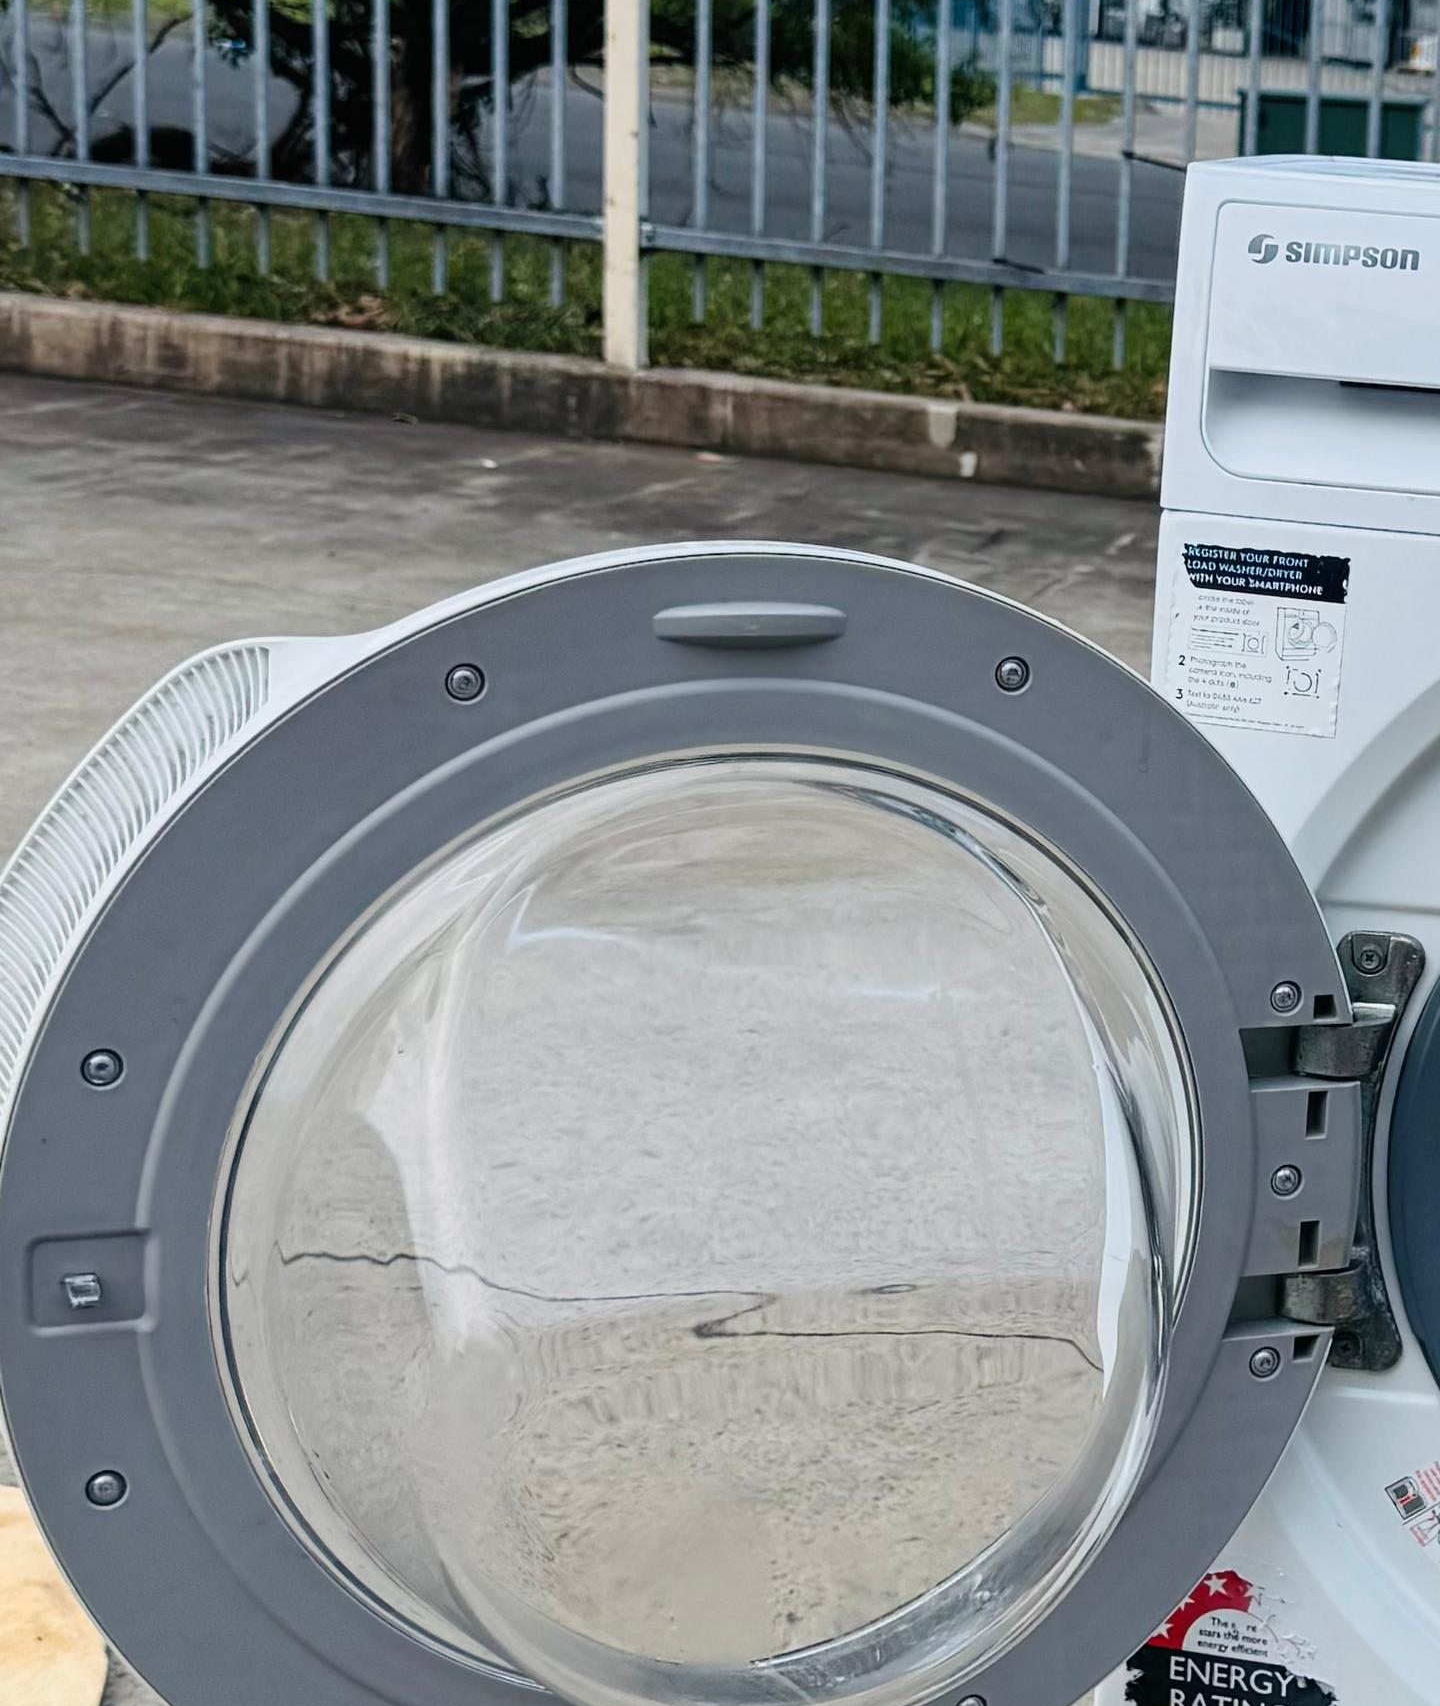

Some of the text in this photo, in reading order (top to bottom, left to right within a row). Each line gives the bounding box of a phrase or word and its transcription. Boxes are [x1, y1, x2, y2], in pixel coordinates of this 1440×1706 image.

[1285, 241, 1420, 271] SIMPSON
[1188, 546, 1309, 568] REGISTER YOUR FRONT
[1187, 559, 1303, 581] LOAD WASHER/DRYER
[1189, 572, 1324, 596] WITH YOUR SMARTPHONE
[1178, 654, 1186, 666] 2
[1176, 688, 1184, 700] 3
[1210, 1616, 1229, 1629] The
[1199, 1629, 1268, 1646] stars the more
[1197, 1639, 1269, 1658] energy efficient
[1169, 1655, 1294, 1698] ENERGY
